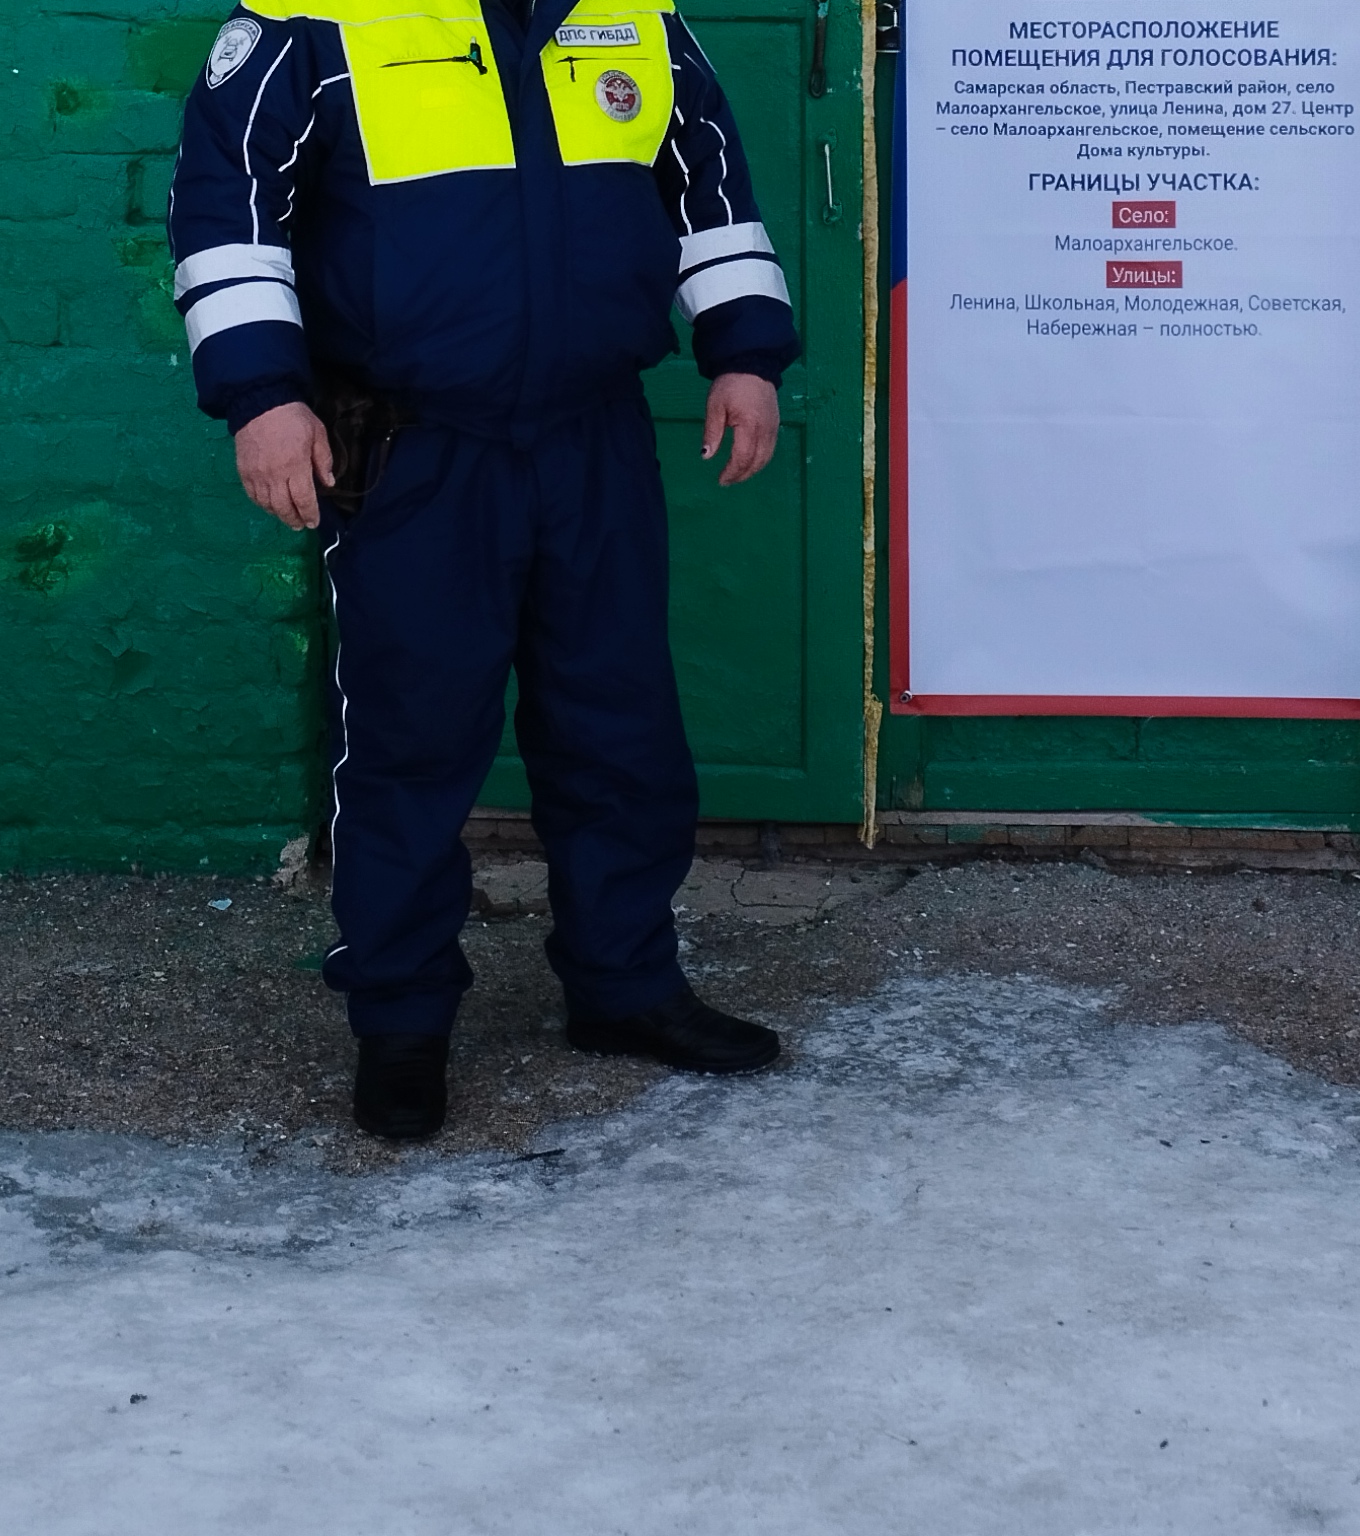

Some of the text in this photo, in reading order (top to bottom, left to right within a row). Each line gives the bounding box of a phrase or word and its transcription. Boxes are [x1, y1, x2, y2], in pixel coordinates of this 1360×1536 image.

[560, 28, 635, 42] ДПС ГИБДД
[1009, 20, 1280, 39] МЕСТОРАСПОЛОЖЕНИЕ
[952, 49, 1337, 70] ПОМЕЩЕНИЯ ДЛЯ ГОЛОСОВАНИЯ:
[954, 80, 1335, 97] Самарская область, Пестравский район, село
[936, 101, 1354, 118] Малоархангельское, улица Ленина, дом 27. Центр
[951, 125, 988, 136] село
[993, 123, 1163, 138] Малоархангельское,
[1167, 125, 1265, 138] помещение
[1270, 125, 1354, 135] сельского
[1077, 144, 1211, 160] Дома культуры.
[1029, 174, 1260, 193] ГРАНИЦЫ УЧАСТКА:
[1119, 208, 1169, 223] Село:
[1055, 235, 1238, 254] Малоархангельское.
[1112, 267, 1176, 285] Улицы:
[950, 294, 1346, 314] Ленина, Школьная, Молодежная, Советская,
[1027, 319, 1137, 338] Набережная
[1160, 324, 1262, 337] полностью.
